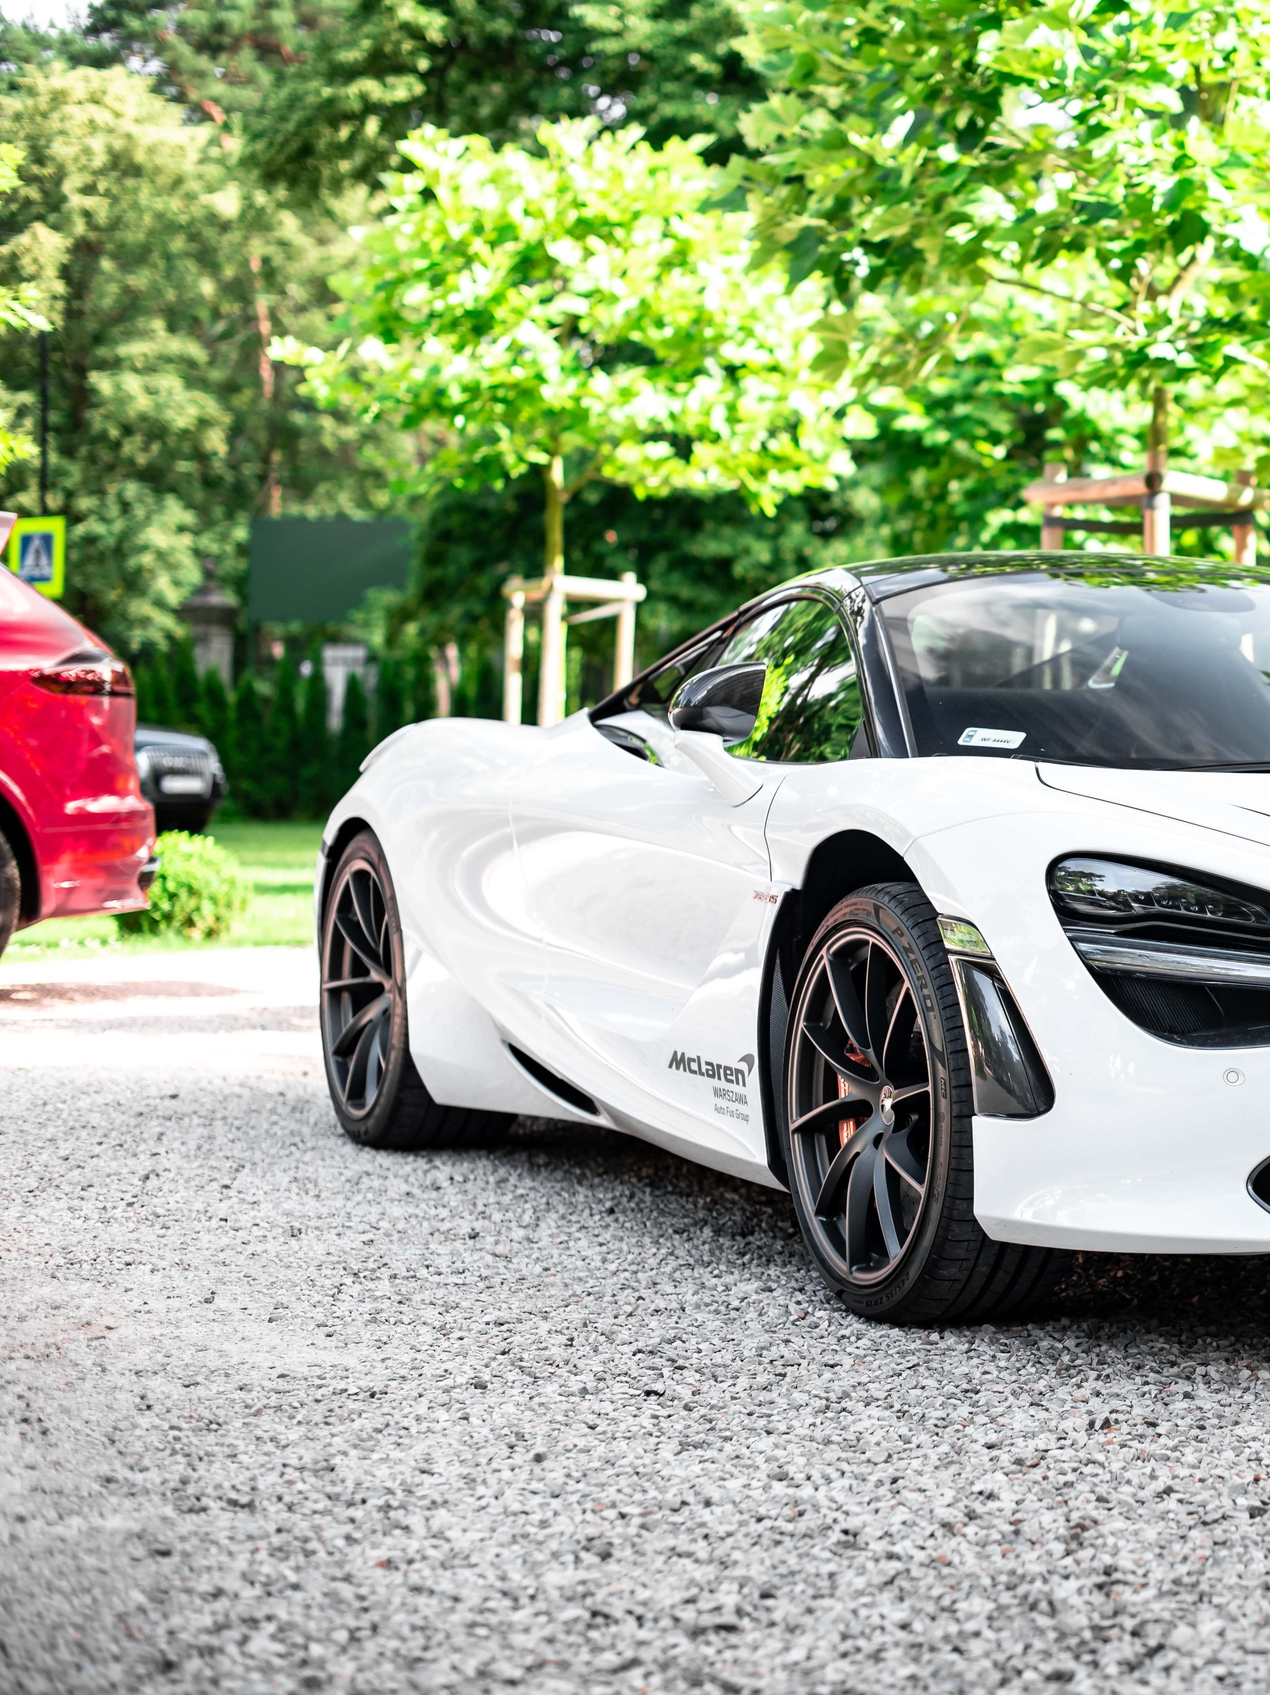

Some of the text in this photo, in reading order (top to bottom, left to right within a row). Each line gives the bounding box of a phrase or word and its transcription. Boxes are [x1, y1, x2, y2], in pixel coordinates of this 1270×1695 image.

[902, 941, 935, 1013] ZERO
[668, 1050, 747, 1088] McLaren
[712, 1086, 749, 1107] WARSZAWA
[714, 1103, 750, 1124] Auto Fus Group
